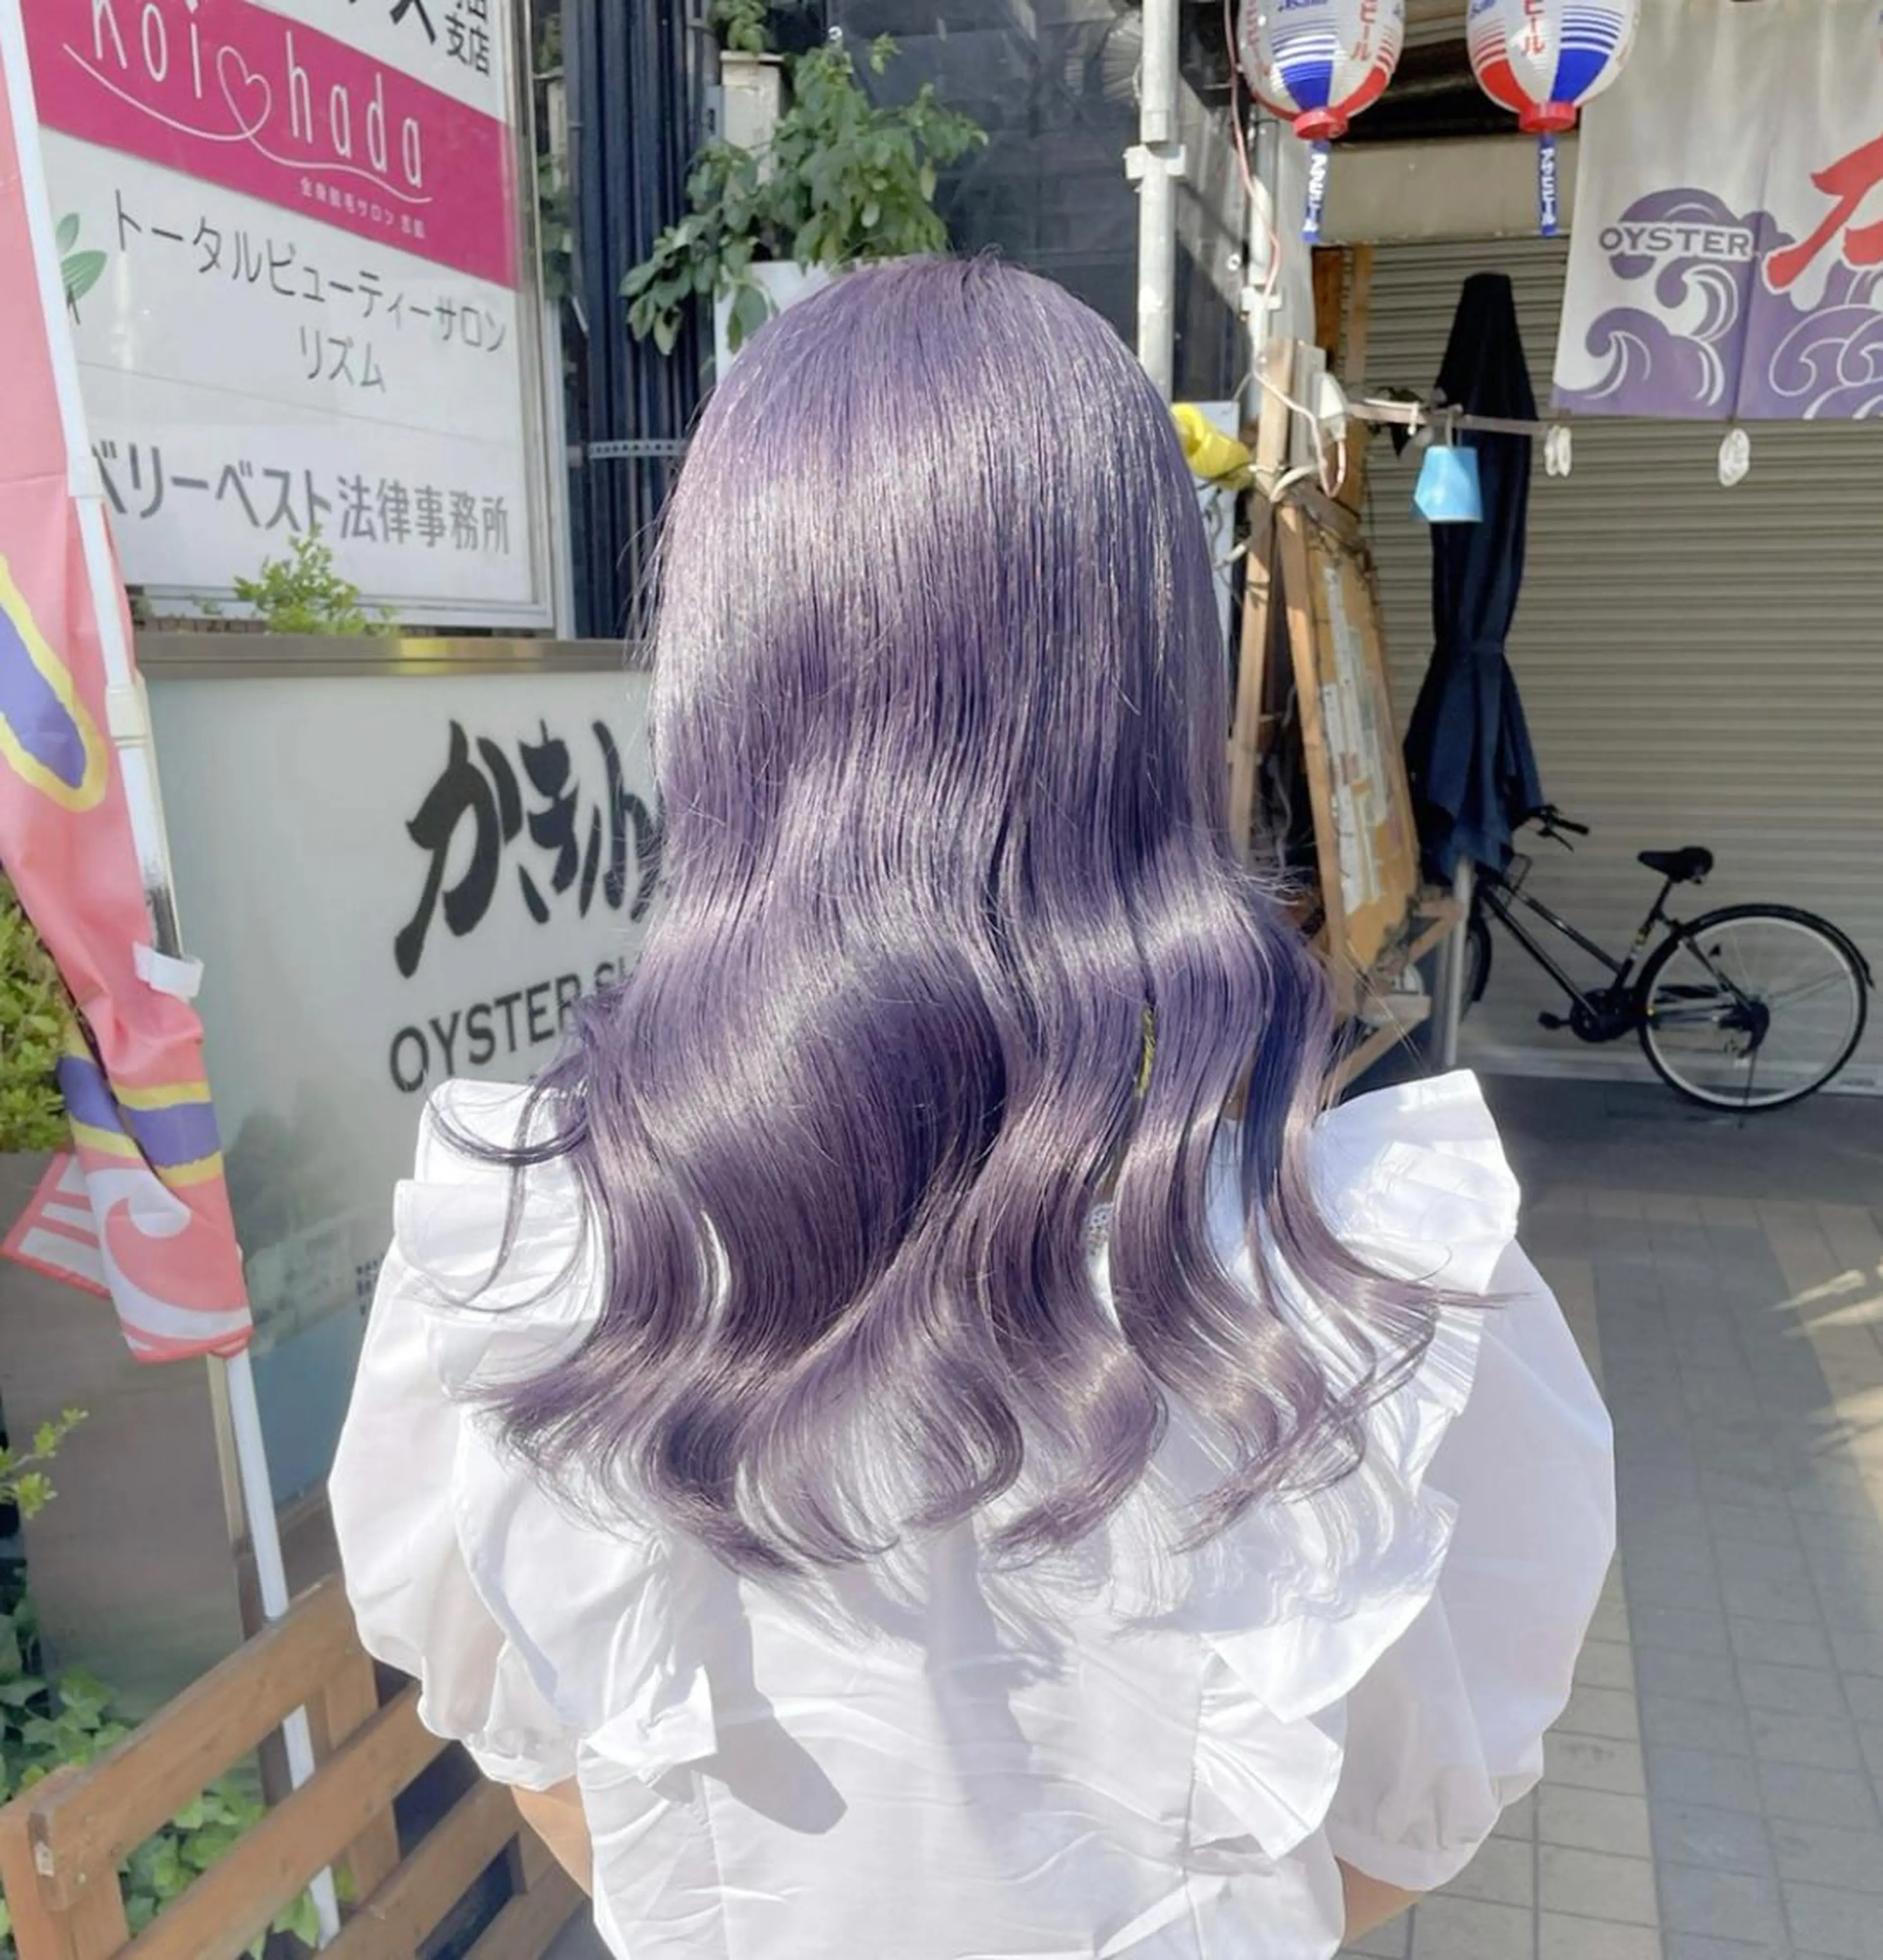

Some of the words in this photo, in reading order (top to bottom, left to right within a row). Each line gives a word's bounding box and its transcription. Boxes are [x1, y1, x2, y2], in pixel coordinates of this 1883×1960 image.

[286, 29, 423, 189] hada
[115, 189, 506, 352] トータルビューティーサロン
[1599, 227, 1751, 257] OYSTER
[300, 326, 386, 393] リズム
[91, 439, 509, 555] ベリーベスト法律事務所
[390, 973, 582, 1093] OYSTER
